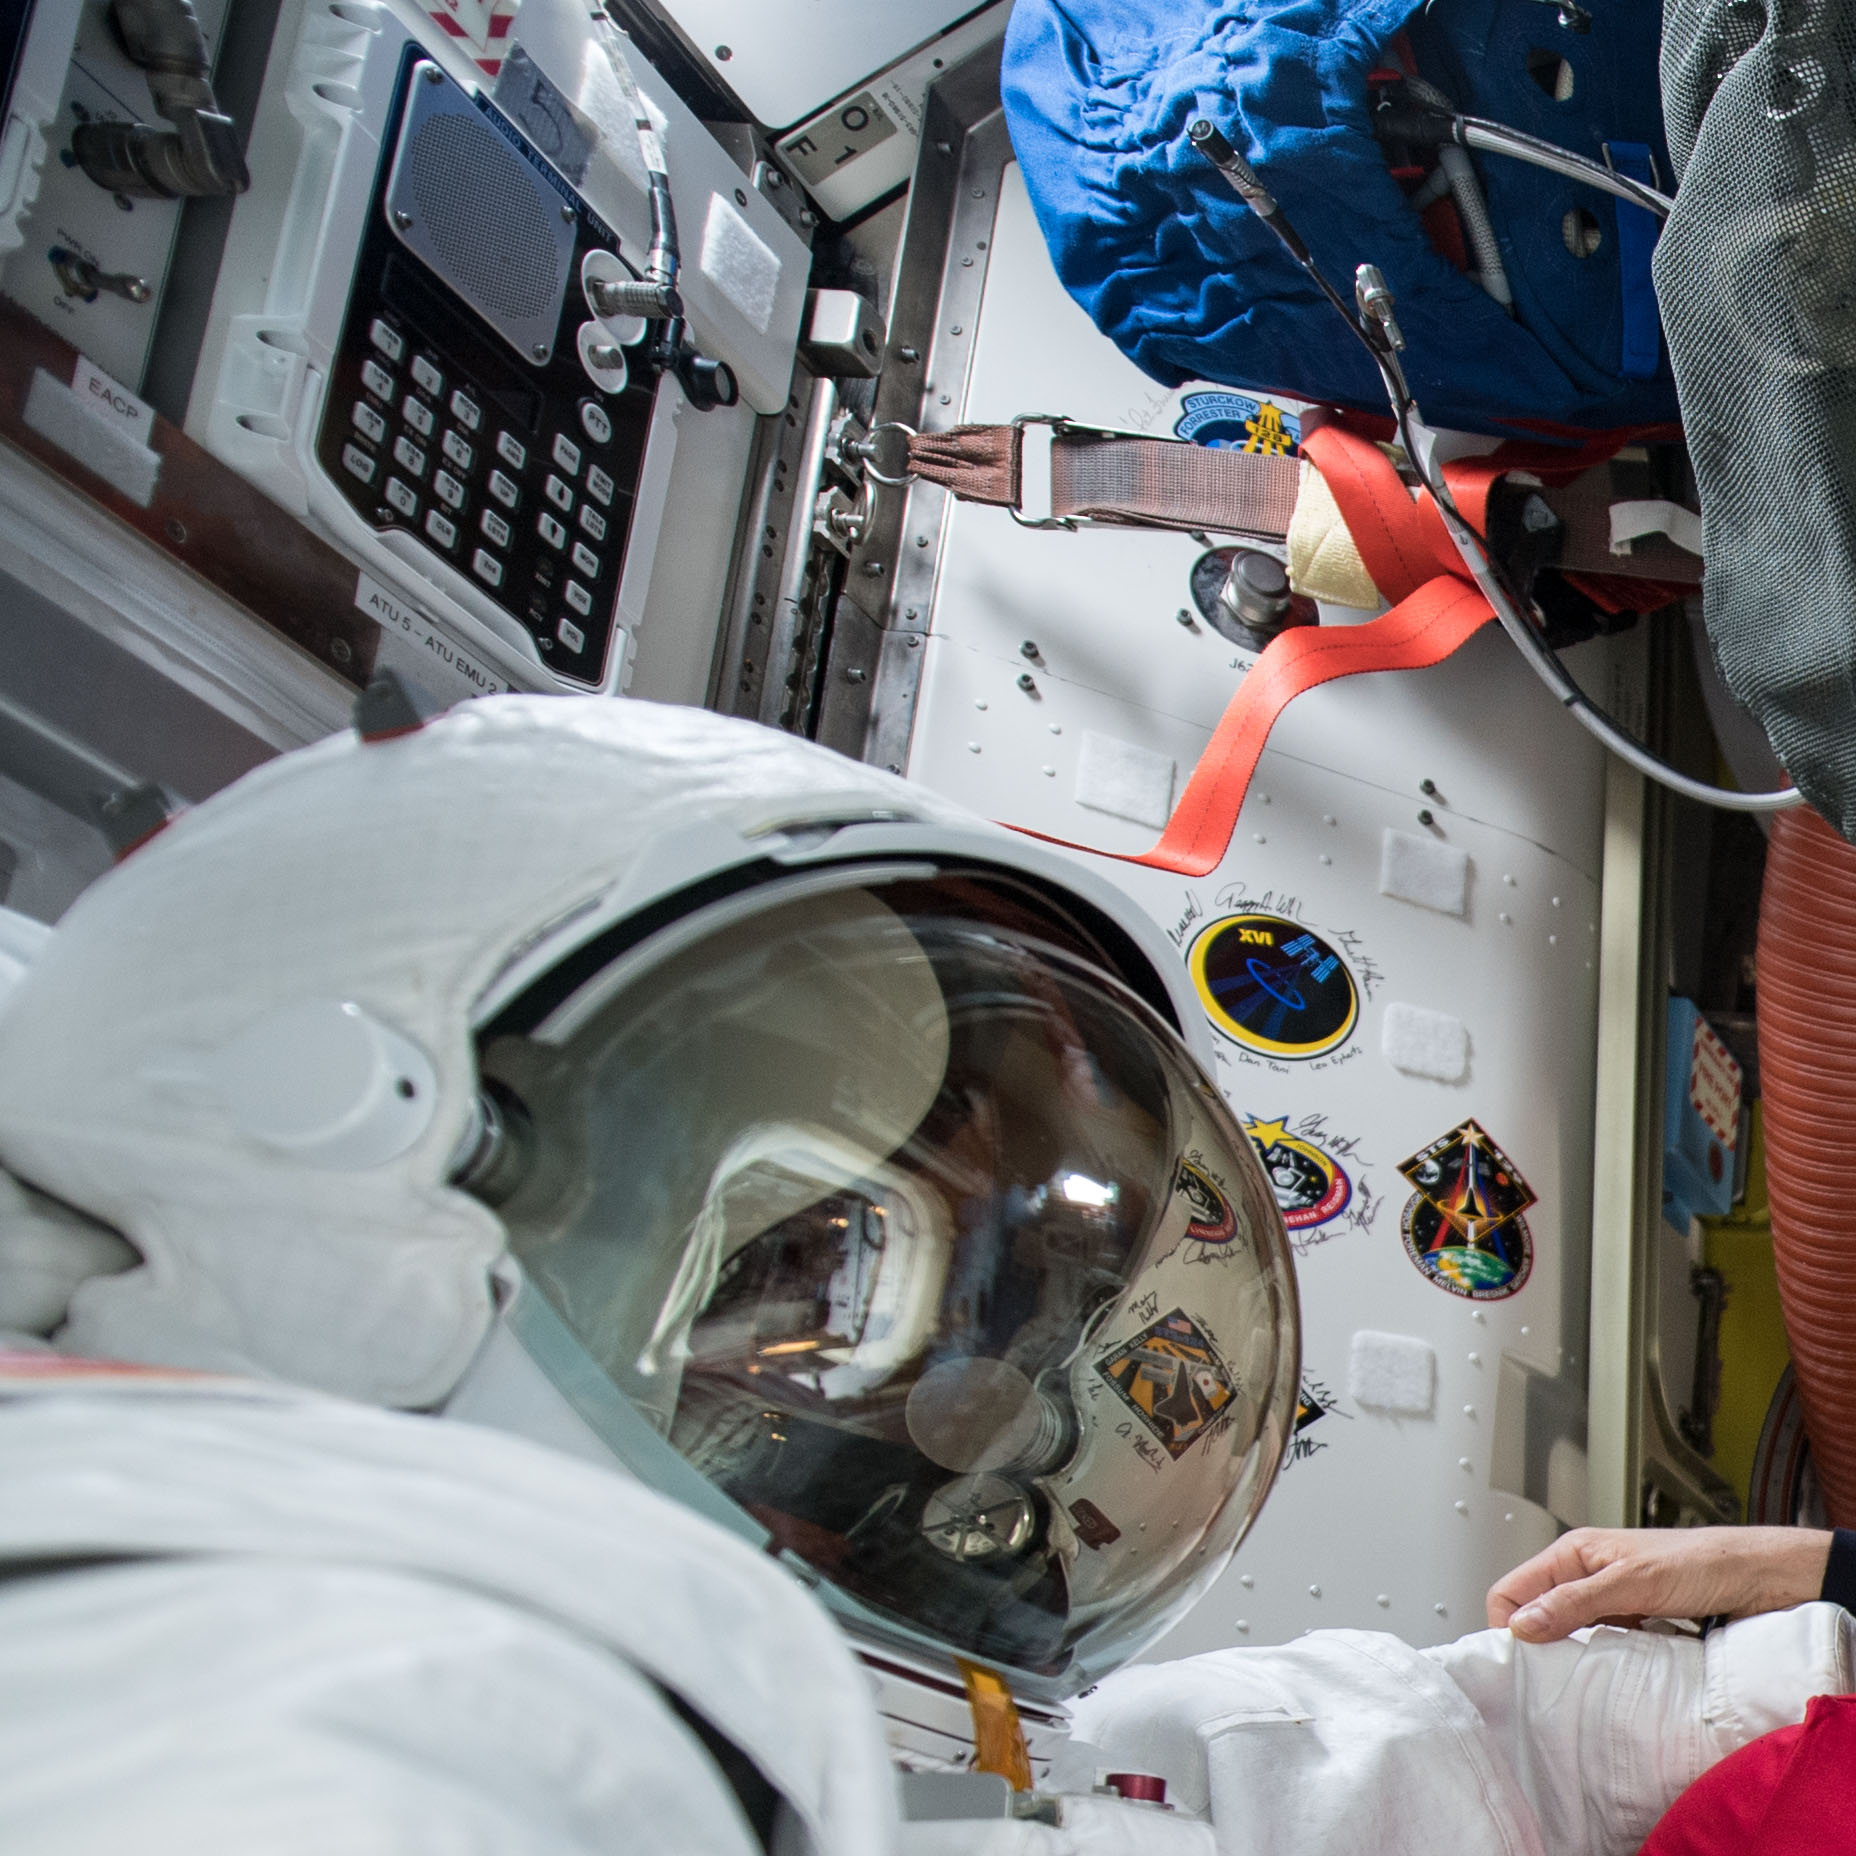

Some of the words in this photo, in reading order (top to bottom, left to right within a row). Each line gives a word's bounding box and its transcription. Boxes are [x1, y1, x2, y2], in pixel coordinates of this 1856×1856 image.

[786, 135, 818, 156] F
[485, 103, 522, 148] AUDIO
[527, 150, 581, 214] TERMINAL
[87, 378, 139, 422] EACP
[1186, 396, 1258, 411] STURCKOW
[588, 412, 608, 433] PTT
[1181, 408, 1241, 435] FORRESTER
[369, 593, 400, 622] ATU
[401, 617, 411, 632] 5
[424, 636, 454, 663] ATU
[455, 658, 487, 688] EMU
[487, 682, 498, 696] 2
[1237, 927, 1275, 947] XVI
[1415, 1137, 1450, 1162] STS
